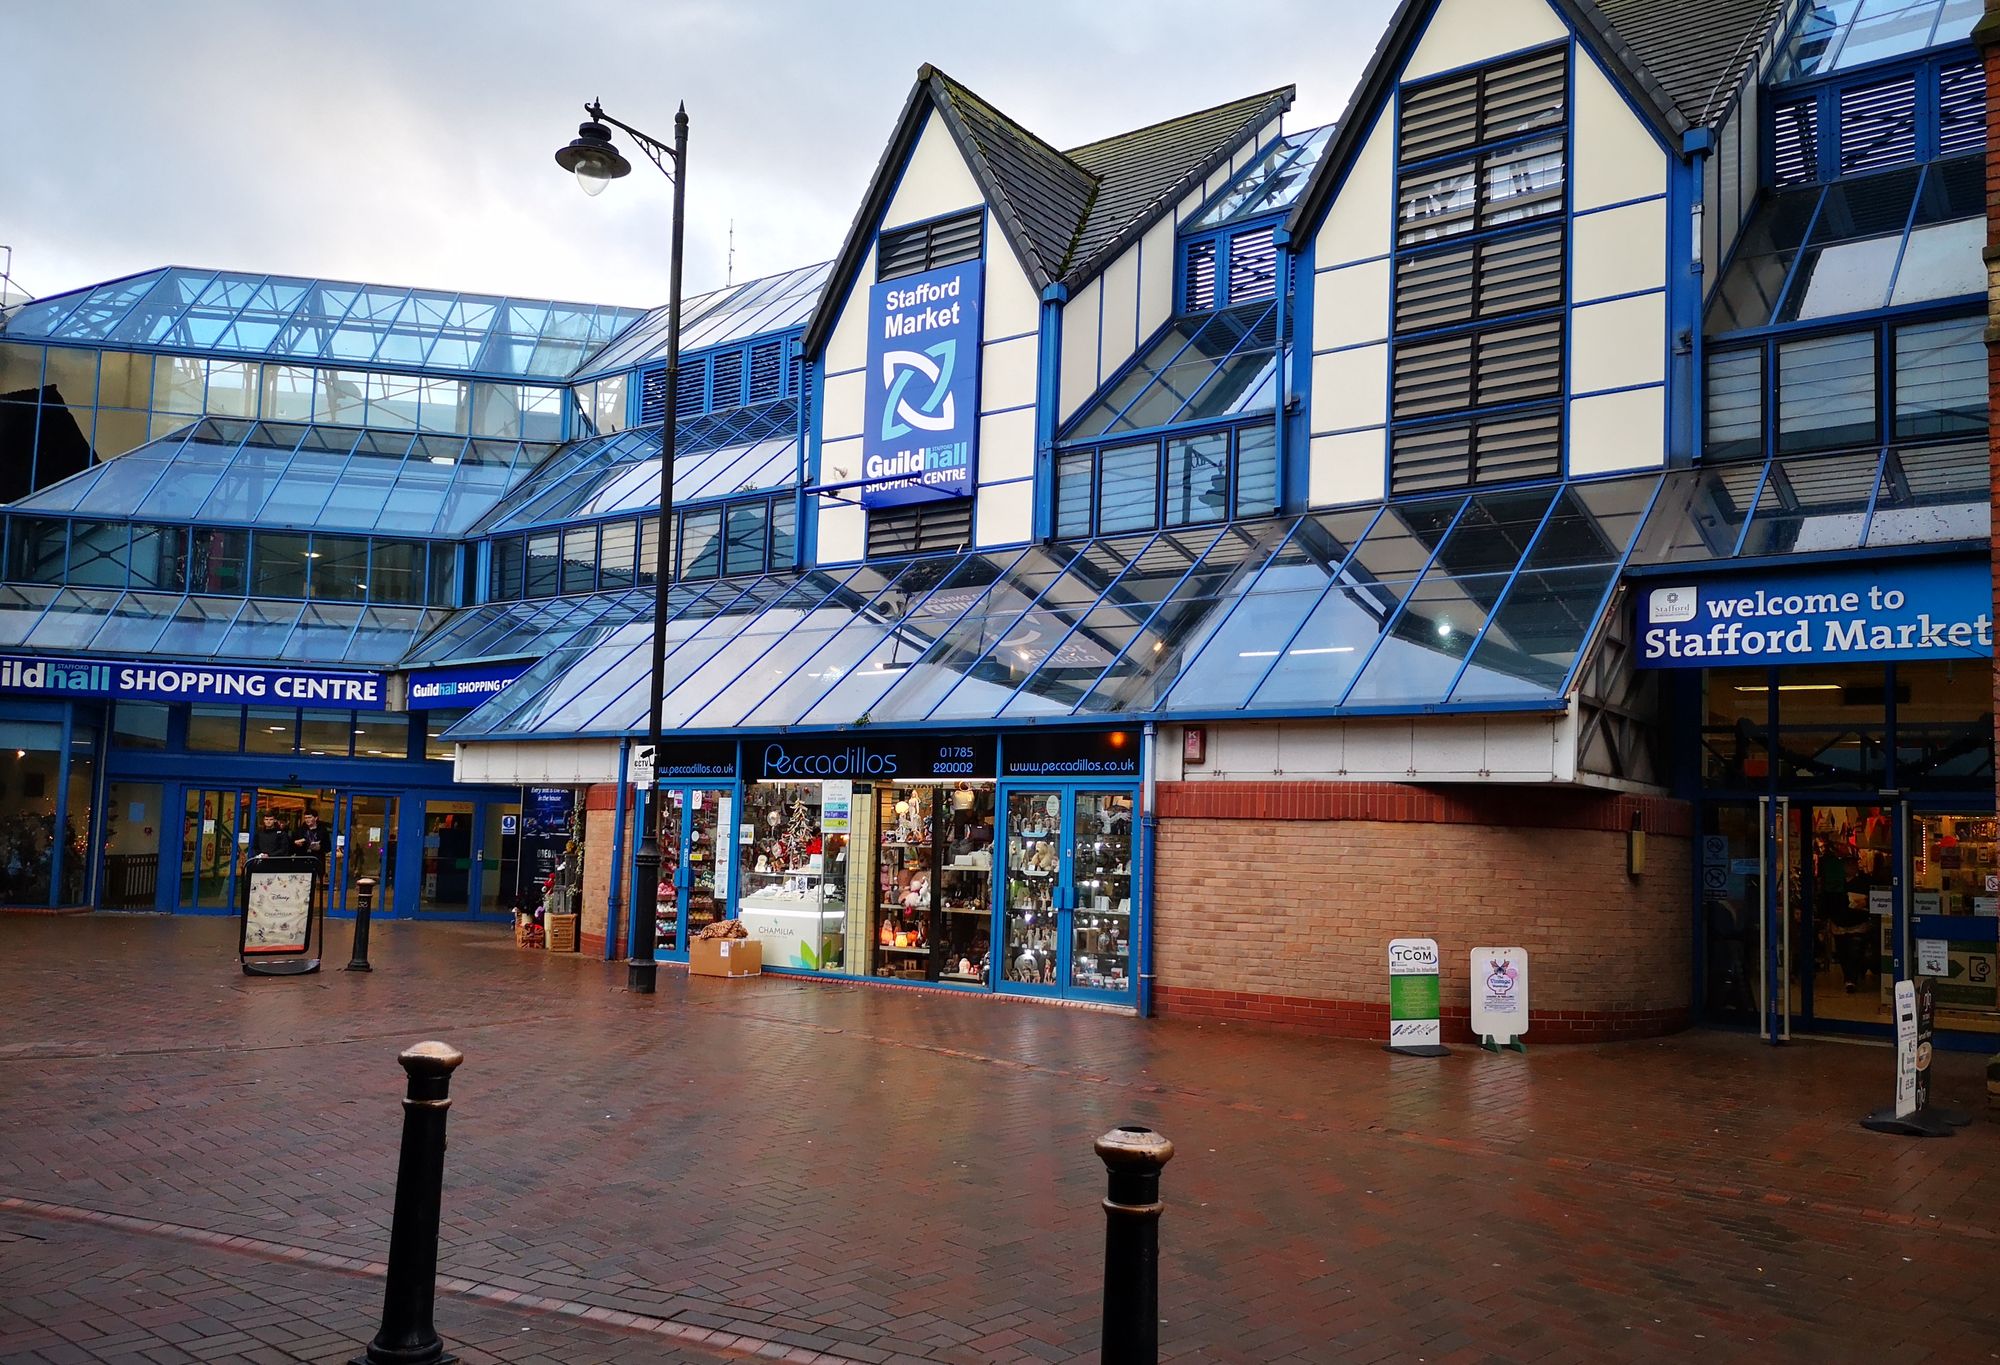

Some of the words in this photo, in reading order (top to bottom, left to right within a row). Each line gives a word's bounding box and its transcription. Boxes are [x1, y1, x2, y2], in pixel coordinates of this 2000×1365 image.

[885, 276, 961, 311] Stafford
[884, 304, 961, 339] Market
[866, 442, 968, 479] Guildhall
[923, 467, 967, 485] CENTRE
[1706, 590, 1859, 619] welcome
[1867, 585, 1905, 611] to
[1645, 619, 1812, 659] Stafford
[1822, 613, 1993, 652] Market
[57, 663, 90, 671] STAFFORD
[119, 668, 266, 696] SHOPPING
[273, 676, 378, 701] CENTRE
[412, 681, 457, 698] Guildhall
[457, 679, 500, 694] SHOPPING
[763, 743, 897, 777] Peccadillos
[939, 746, 974, 758] 01785
[932, 762, 974, 773] 220002
[1009, 758, 1135, 775] www.peccadillos.co.uk
[271, 894, 290, 902] Disney
[758, 926, 794, 936] CHAMILIA
